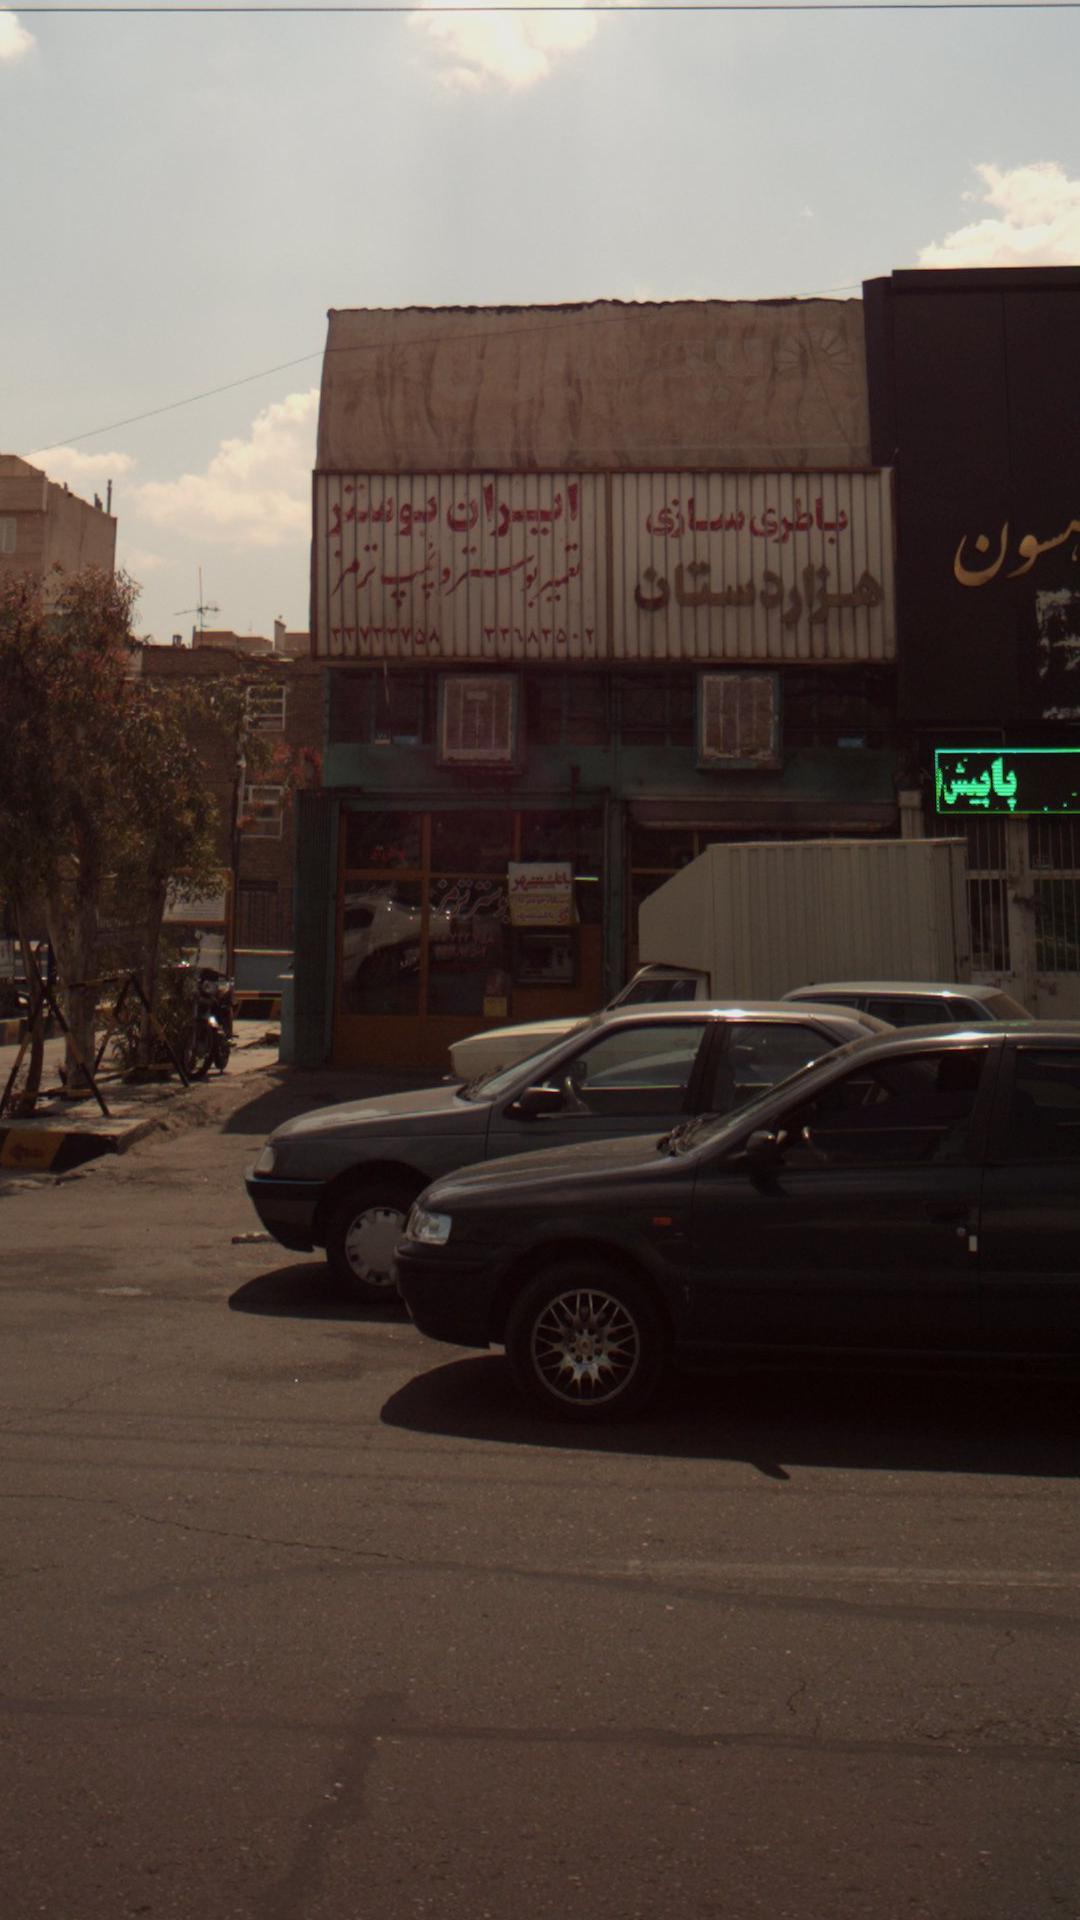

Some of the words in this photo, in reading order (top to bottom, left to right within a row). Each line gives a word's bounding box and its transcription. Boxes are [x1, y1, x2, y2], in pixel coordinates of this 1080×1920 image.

[447, 482, 578, 537] ایران
[646, 497, 745, 539] سازی
[749, 497, 848, 544] باطری
[329, 543, 379, 597] ترمز
[532, 543, 581, 602] تعمیر
